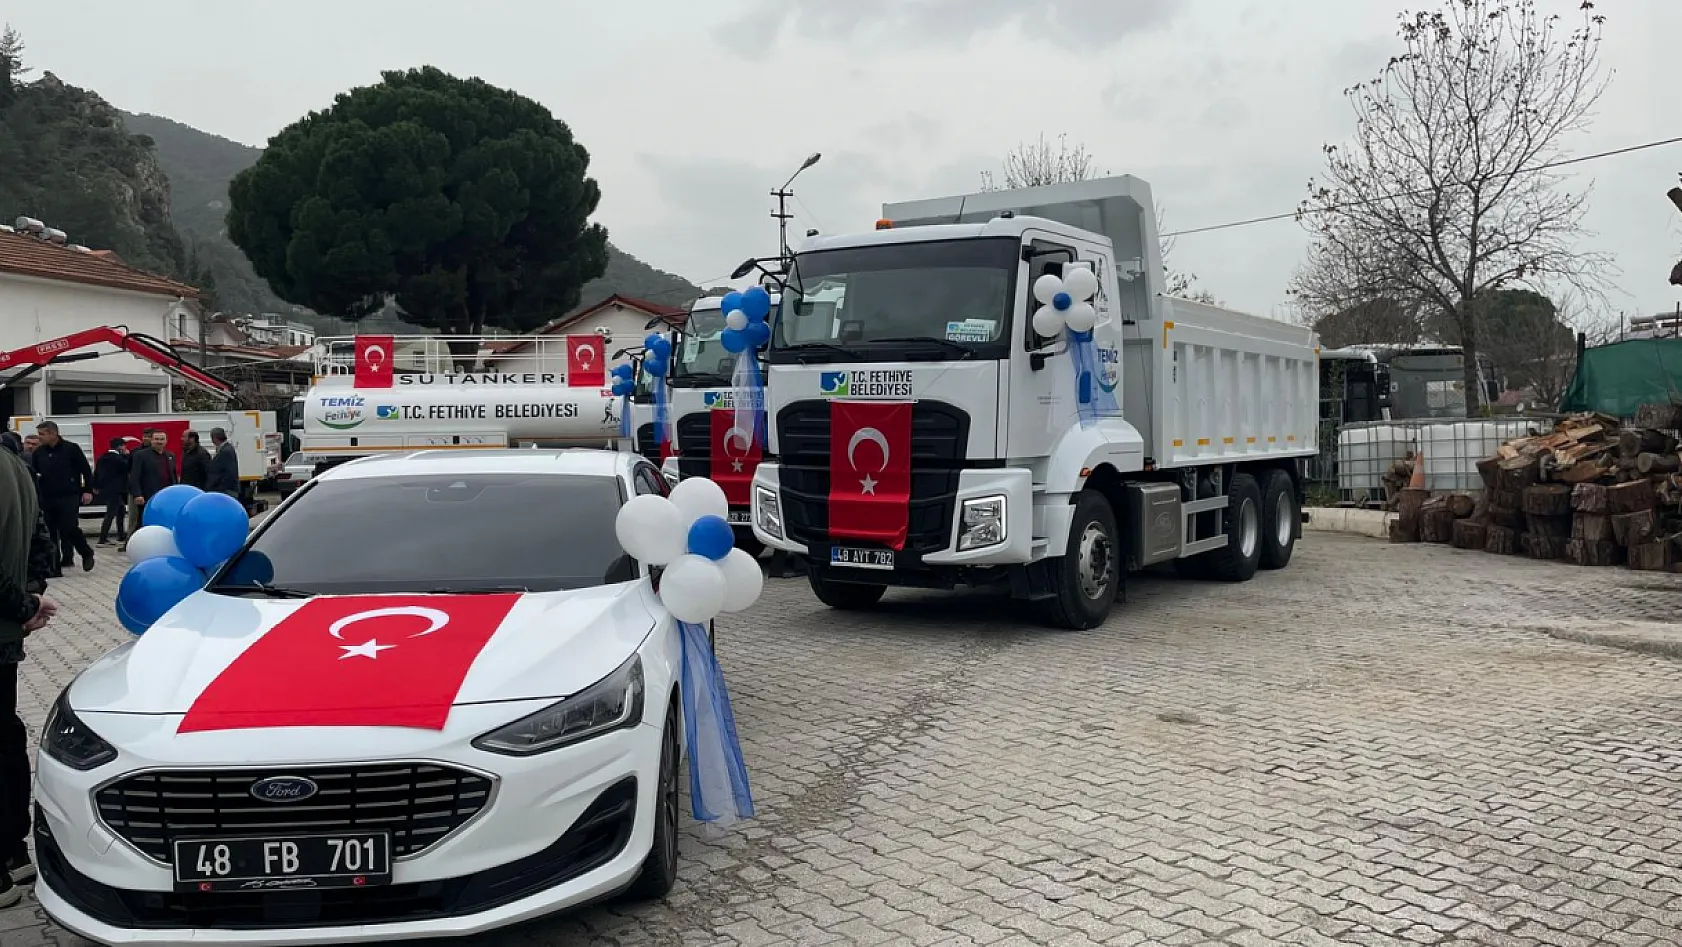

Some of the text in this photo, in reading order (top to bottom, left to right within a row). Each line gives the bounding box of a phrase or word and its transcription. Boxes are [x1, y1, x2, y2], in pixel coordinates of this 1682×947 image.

[400, 374, 434, 385] SU
[850, 370, 867, 383] T.C.
[401, 404, 424, 419] T.C.
[838, 549, 892, 565] 48 AYT 782
[265, 782, 301, 797] Ford
[196, 837, 374, 876] 48 FB 701
